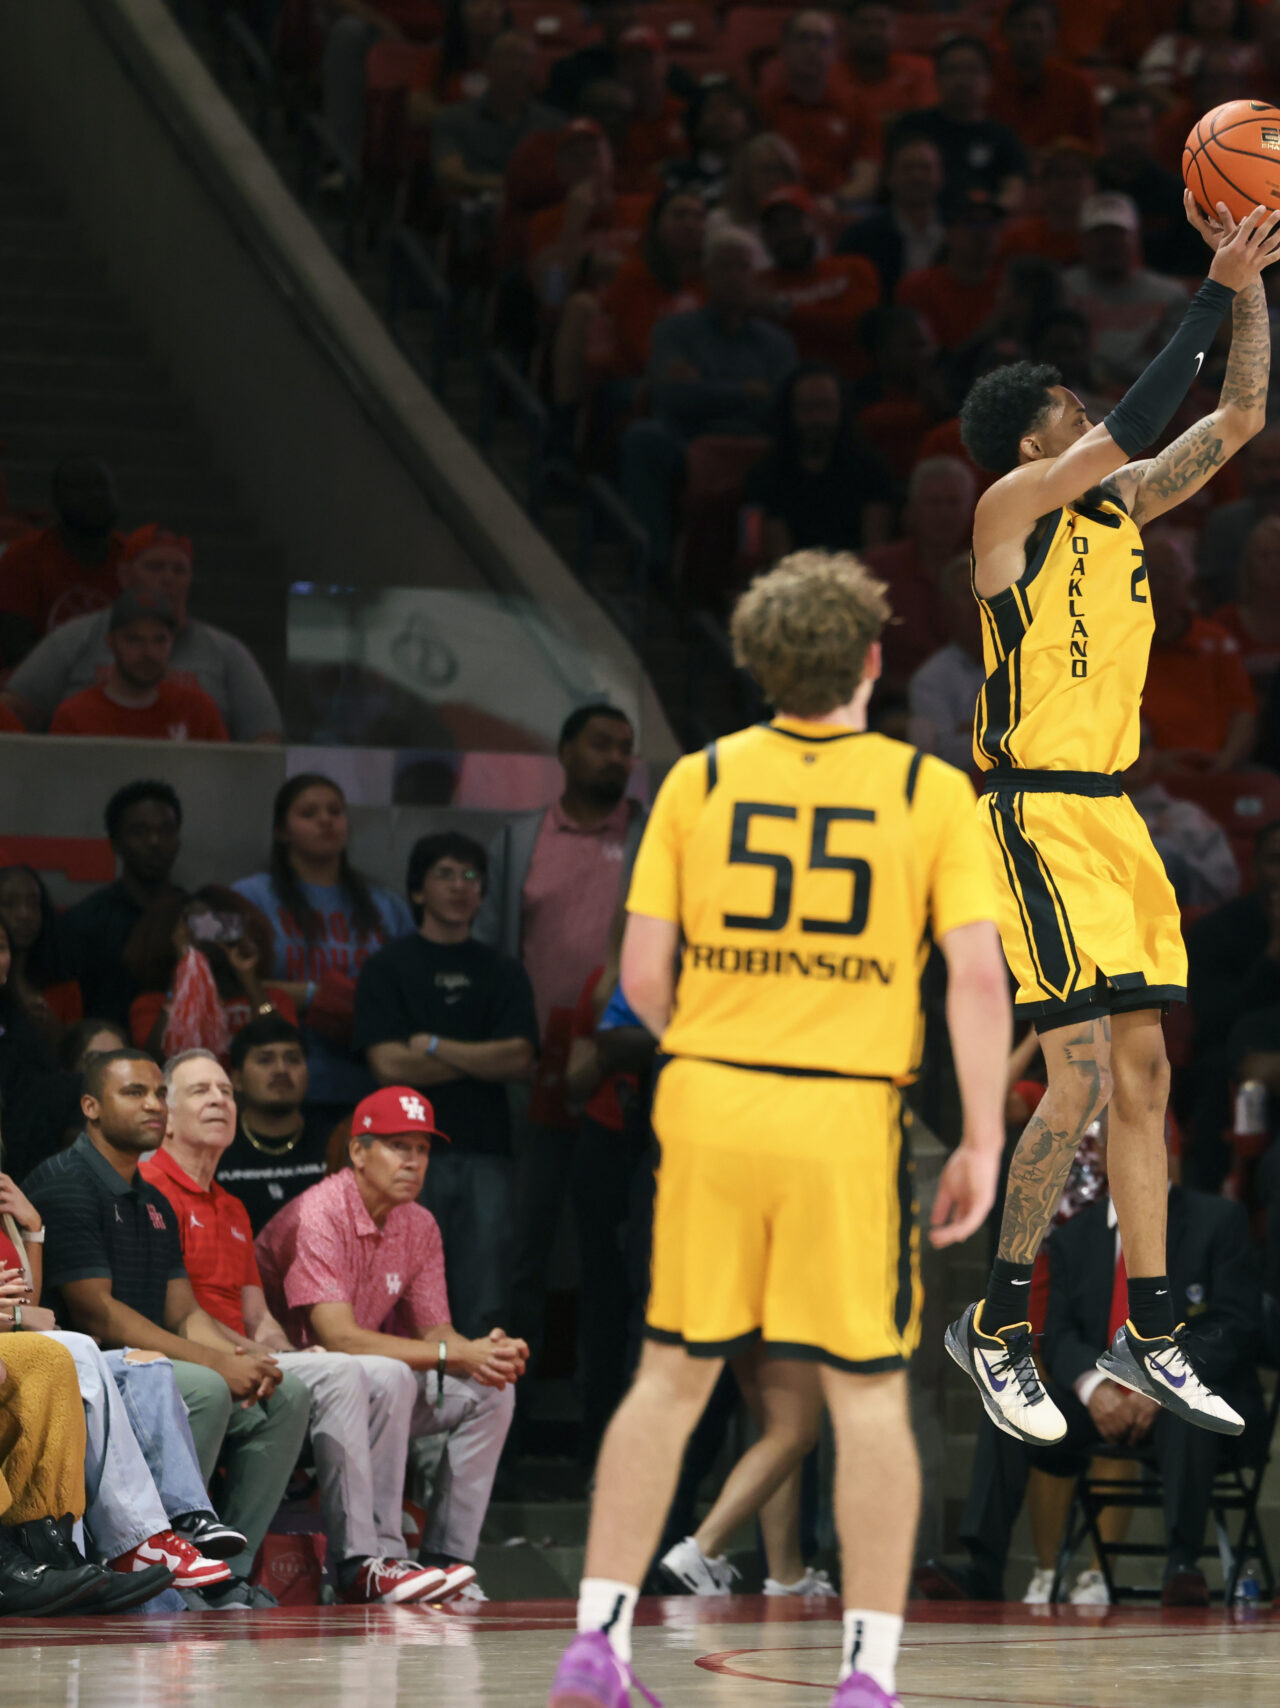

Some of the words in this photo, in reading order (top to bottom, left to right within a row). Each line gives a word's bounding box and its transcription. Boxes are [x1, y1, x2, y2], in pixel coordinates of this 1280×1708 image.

[1131, 548, 1148, 604] 2
[1068, 536, 1089, 678] OAKLAND
[722, 801, 876, 936] 55
[692, 944, 897, 985] ROBINSON
[399, 1096, 426, 1122] UH
